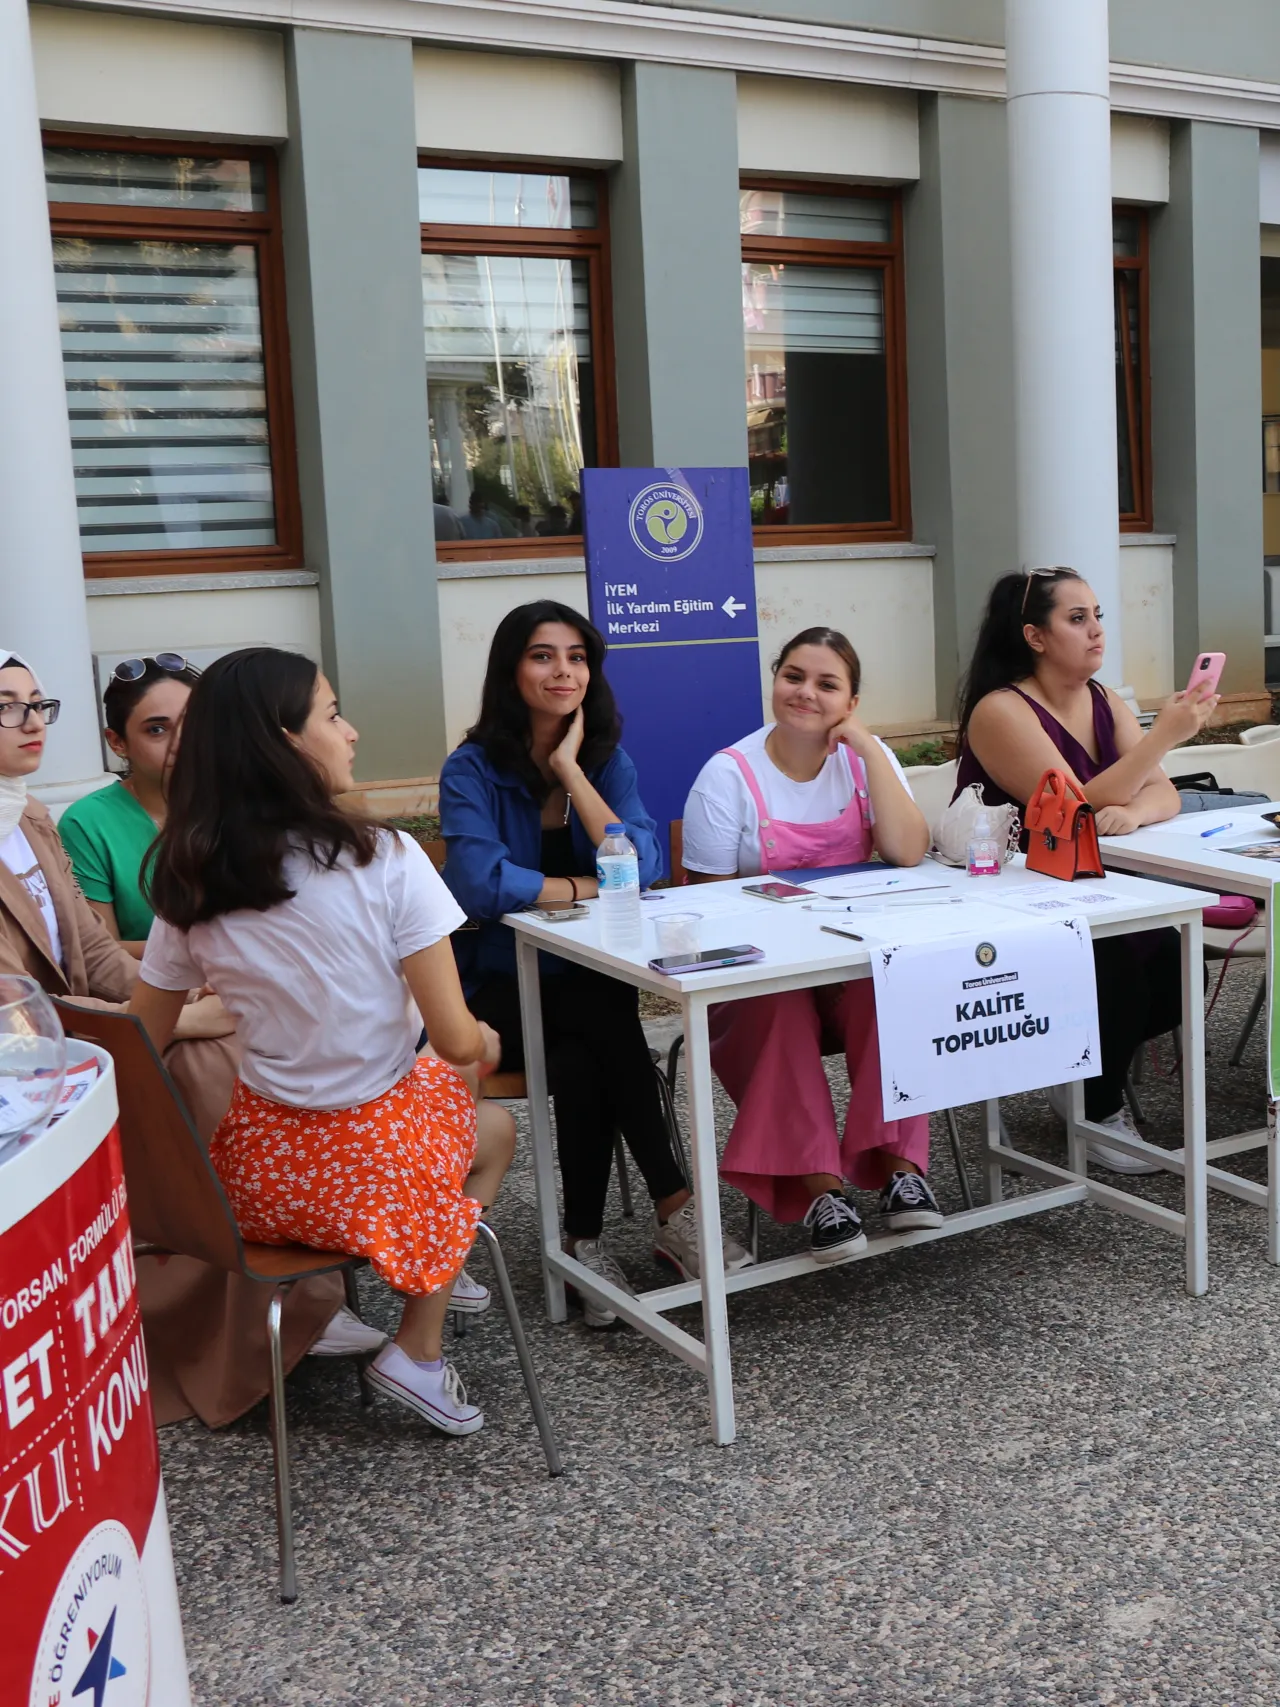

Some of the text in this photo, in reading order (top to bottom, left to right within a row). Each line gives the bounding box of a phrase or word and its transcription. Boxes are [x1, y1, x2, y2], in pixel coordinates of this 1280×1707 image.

[636, 490, 697, 521] TOROS ÜNİVERSİTESİ
[661, 546, 677, 554] 2009
[604, 582, 638, 597] İYEM
[607, 599, 714, 615] İlk Yardım Eğitim
[608, 620, 660, 634] Merkezi
[964, 980, 982, 989] Toros
[955, 991, 1024, 1022] KALİTE
[932, 1014, 1050, 1056] TOPLULUĞU
[0, 1258, 68, 1329] ORSAN,
[68, 1189, 119, 1272] FORMÜLÜ
[0, 1330, 55, 1430] ET
[48, 1553, 123, 1682] ÖĞRENİYORUM
